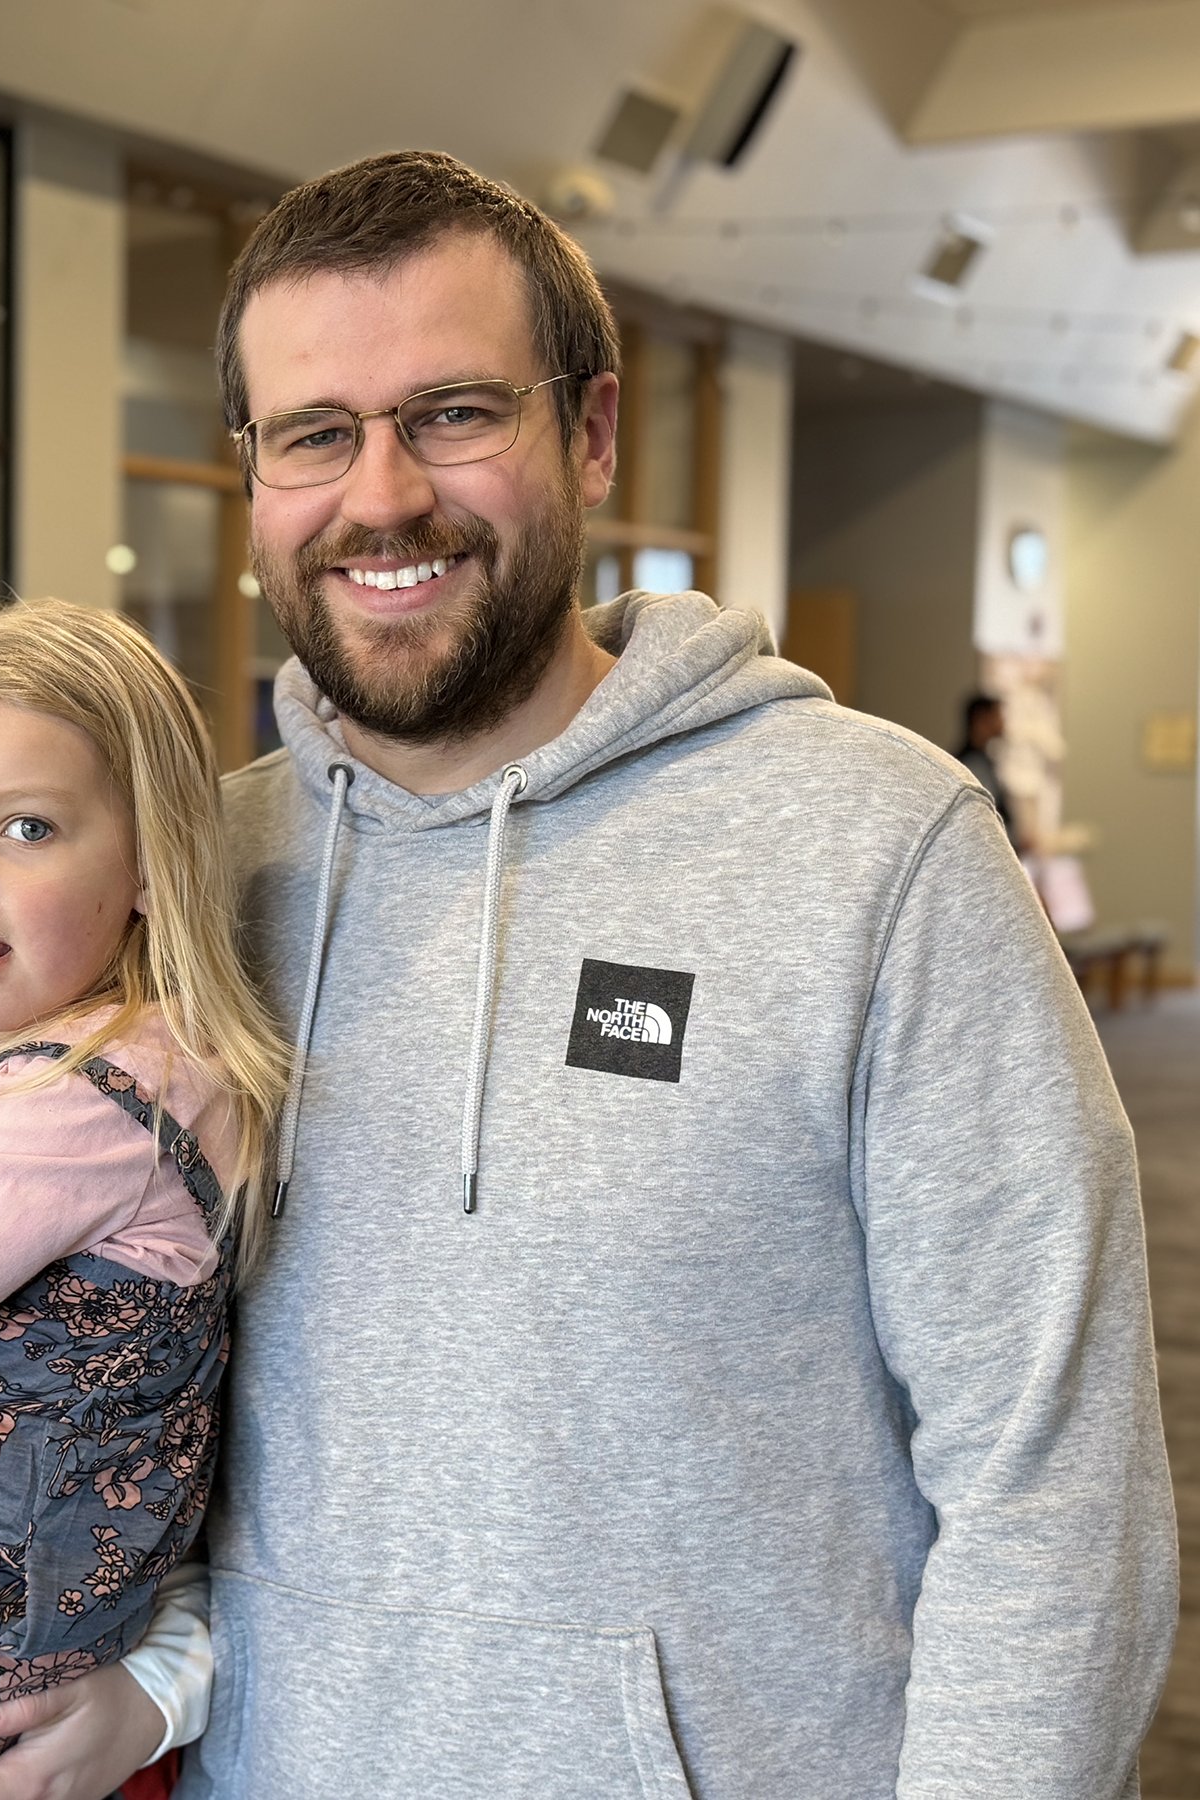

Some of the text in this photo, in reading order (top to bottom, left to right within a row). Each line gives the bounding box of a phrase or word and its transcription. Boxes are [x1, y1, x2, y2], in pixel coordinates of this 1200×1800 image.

[614, 998, 646, 1015] THE
[586, 1008, 644, 1028] NORTH
[600, 1023, 642, 1041] FACE
